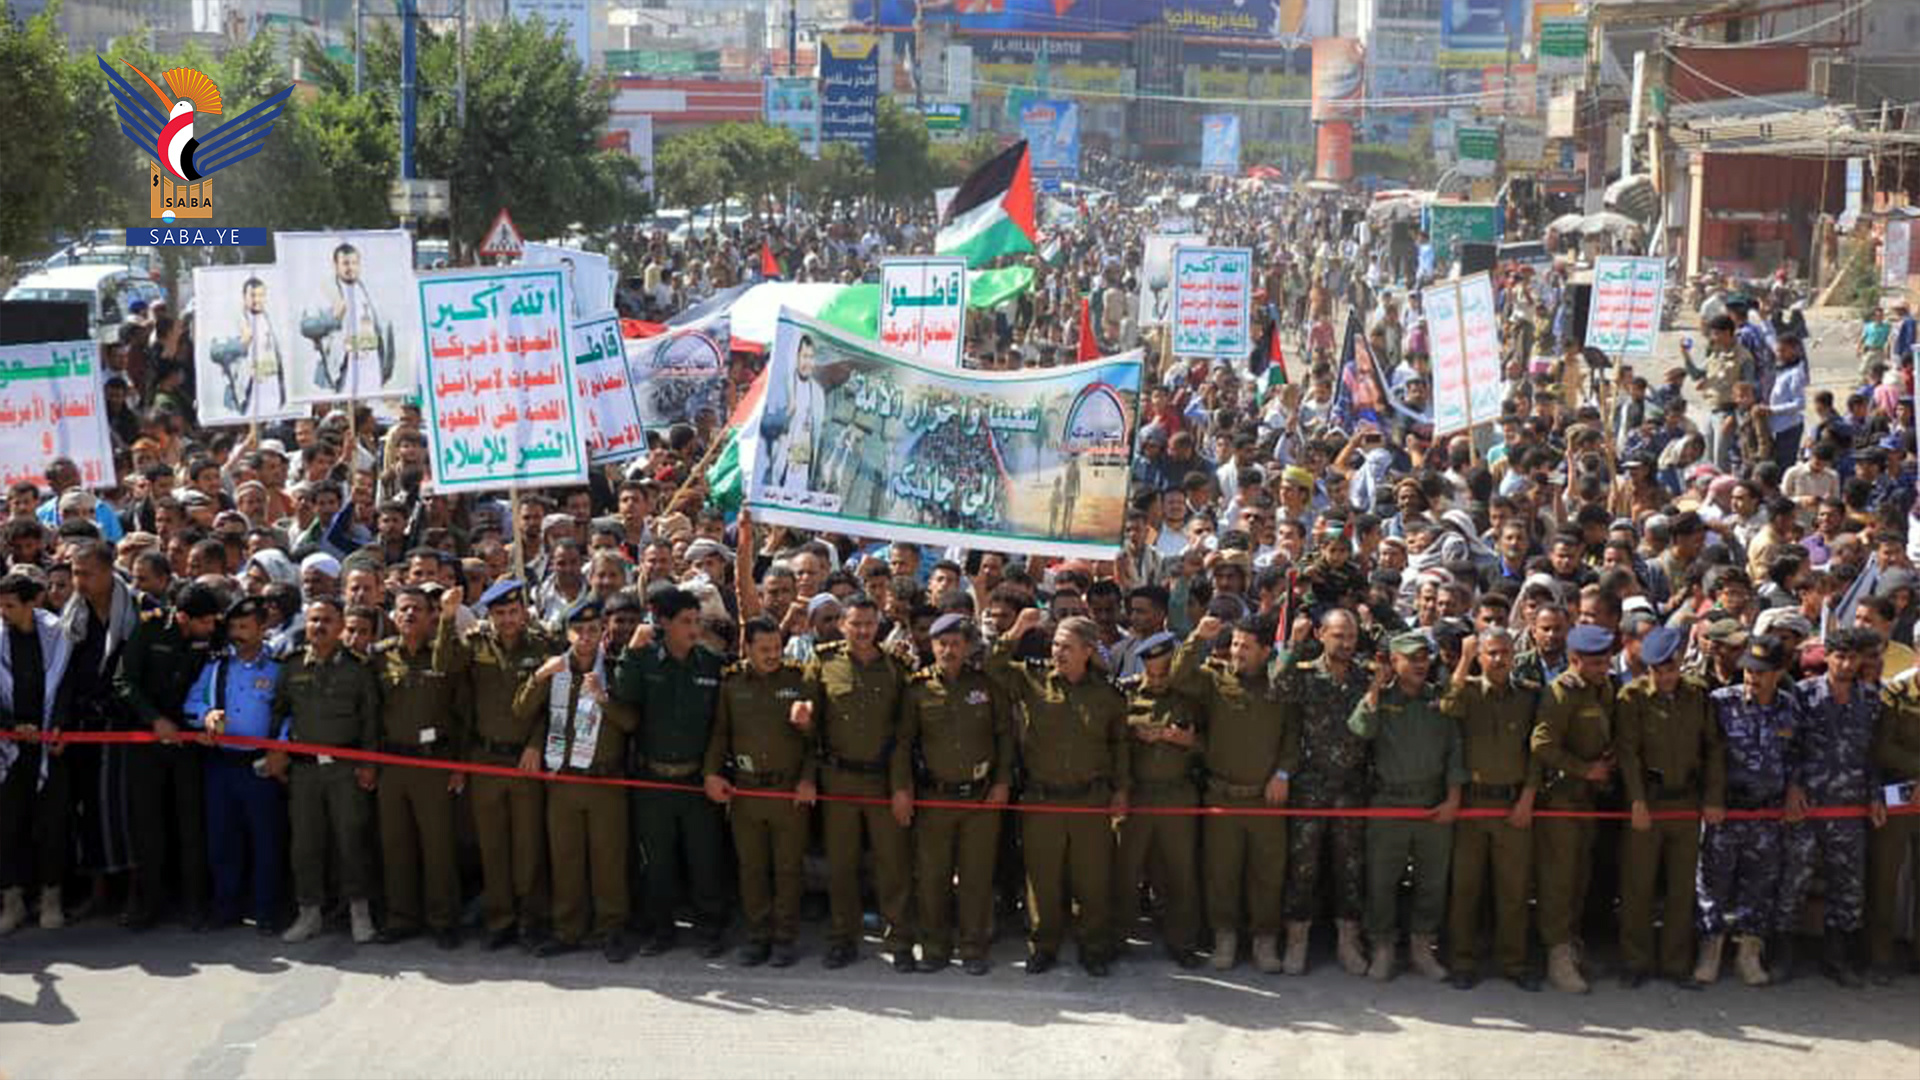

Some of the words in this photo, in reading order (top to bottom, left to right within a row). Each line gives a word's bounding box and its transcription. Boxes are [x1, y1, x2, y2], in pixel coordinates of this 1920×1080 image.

[430, 281, 505, 331] أكبر
[510, 283, 557, 316] الله
[884, 271, 959, 317] قاطعوا
[505, 327, 559, 357] الموت
[575, 326, 620, 365] قاط
[508, 364, 562, 392] الموت
[515, 428, 571, 469] النصر
